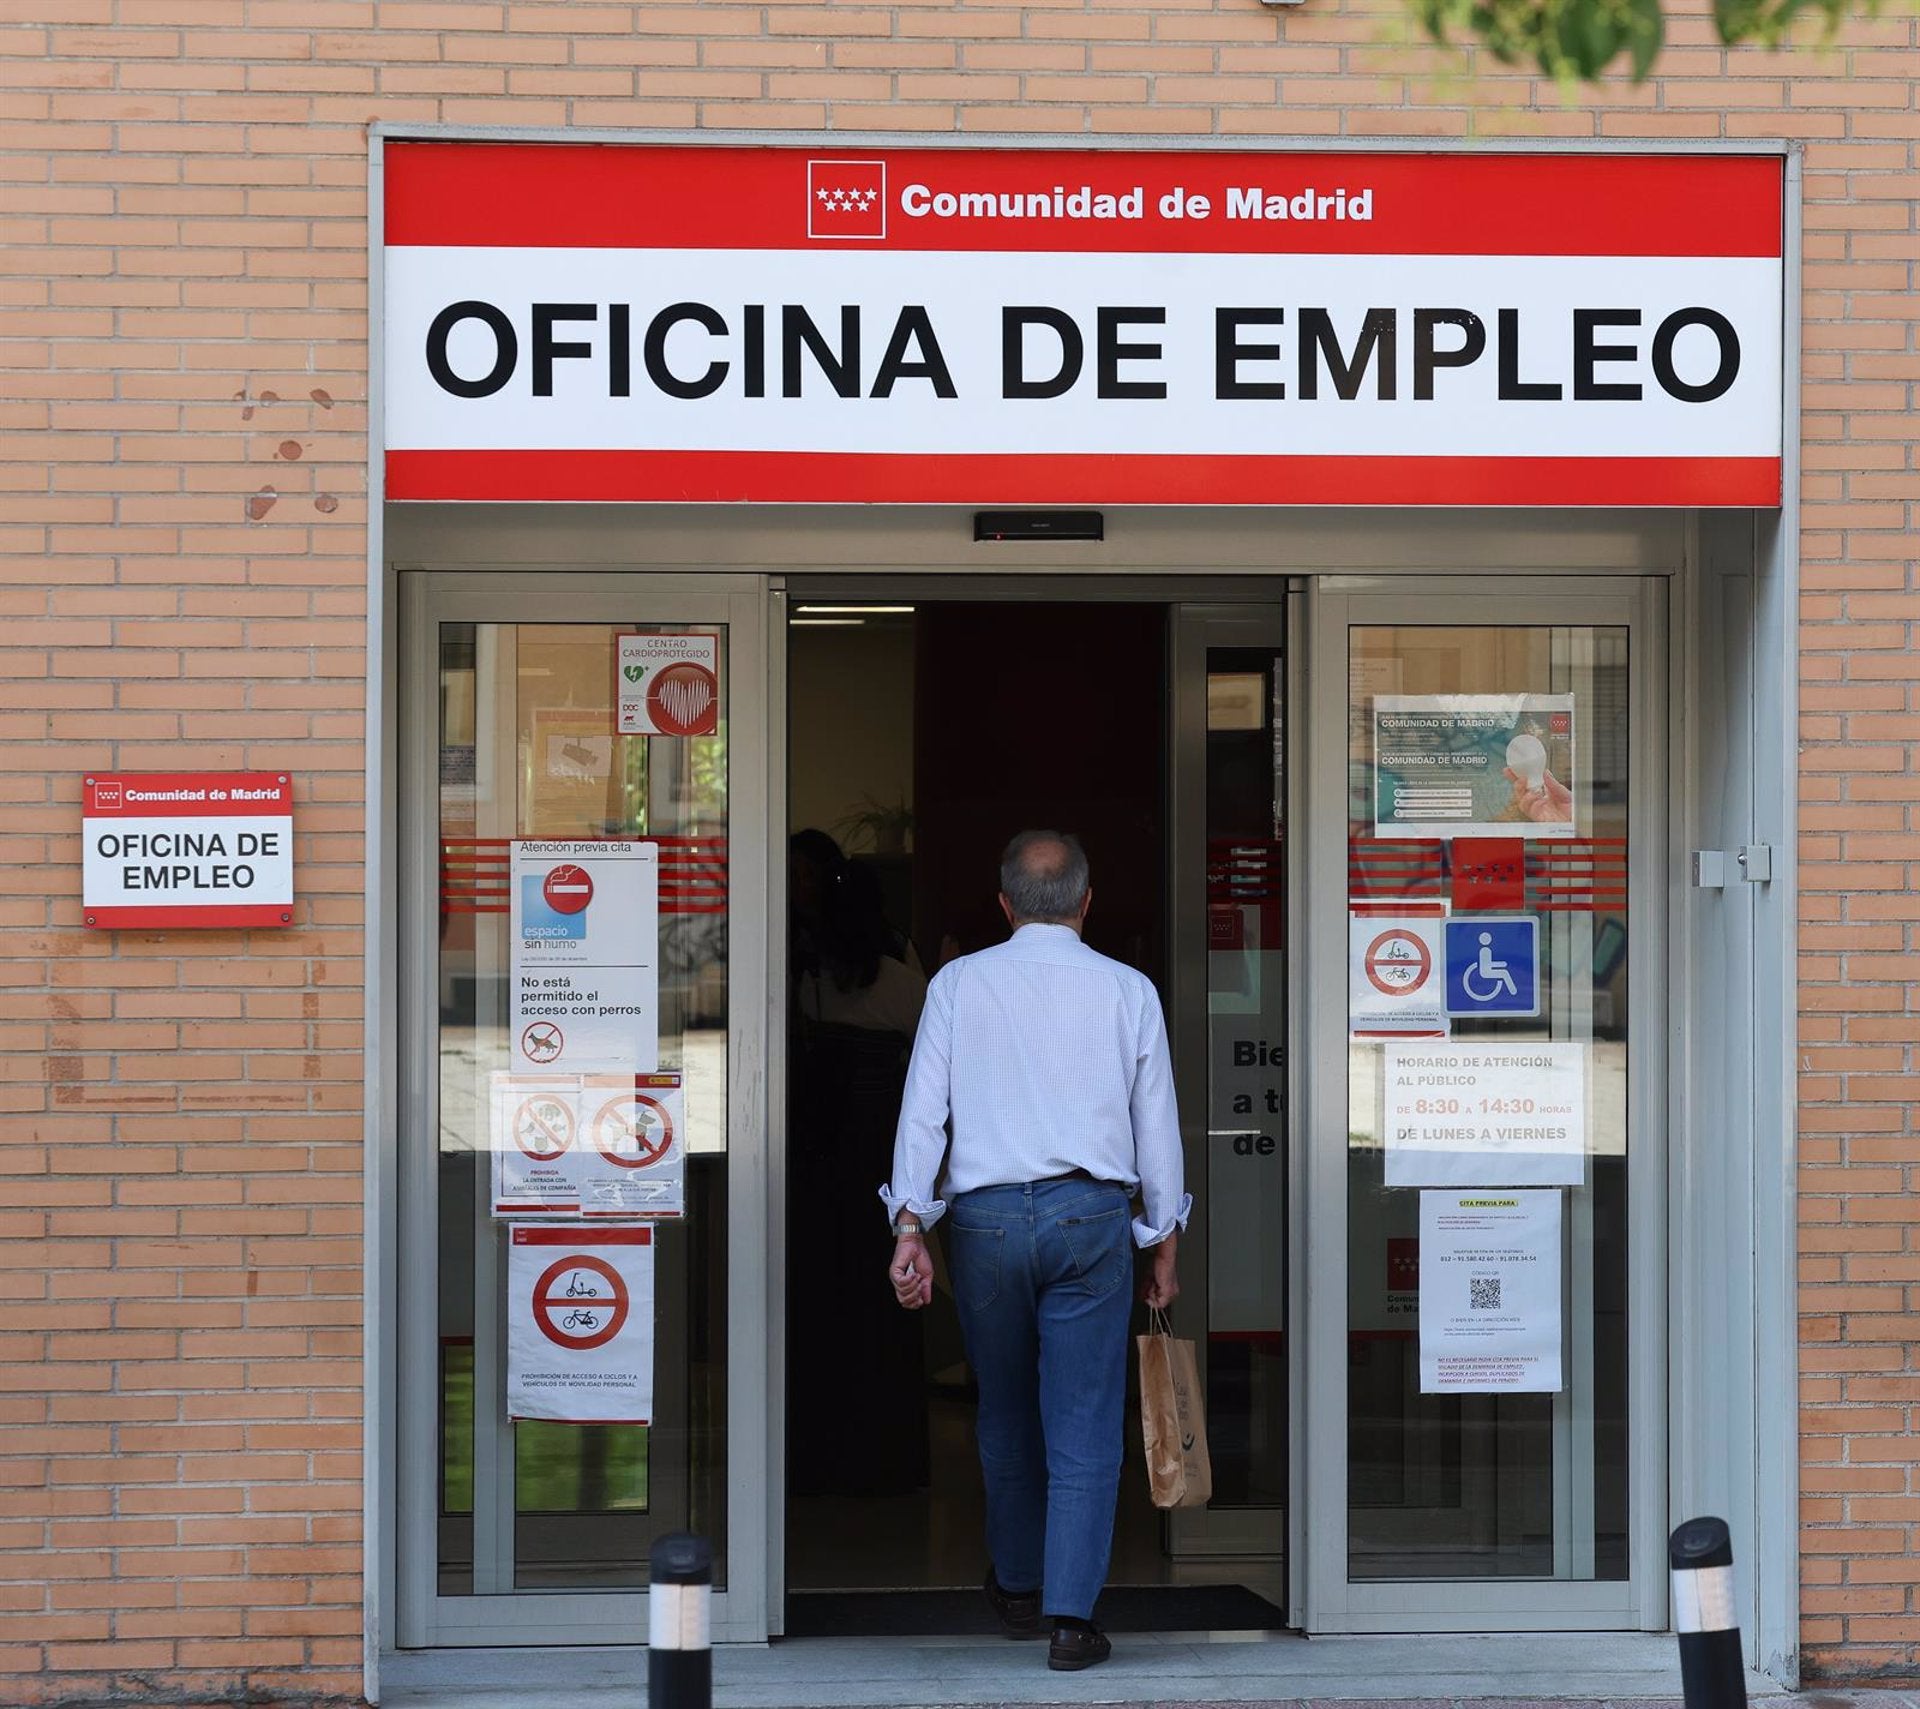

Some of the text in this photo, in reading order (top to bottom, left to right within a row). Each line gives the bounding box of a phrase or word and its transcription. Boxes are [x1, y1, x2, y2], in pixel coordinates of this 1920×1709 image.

[902, 185, 1372, 220] Comunidad de Madrid
[426, 301, 1740, 402] OFICINA DE EMPLEO
[647, 640, 687, 648] CENTRO
[623, 649, 710, 658] CARDIOPROTEGIDO
[1381, 719, 1494, 728] COMUNIDAD DE MADRID
[1381, 756, 1488, 764] COMUNIDAD DE MADRID
[125, 788, 281, 802] Comunidad de Madrid
[97, 833, 279, 858] OFICINA DE
[520, 841, 631, 854] Atención previa cita
[123, 864, 255, 890] EMPLEO
[524, 926, 569, 939] espacio
[524, 938, 577, 949] sin humo
[521, 977, 571, 988] No está
[521, 991, 599, 1003] permitido el
[521, 1006, 642, 1017] acceso con perros
[1397, 1055, 1553, 1068] HORARIO DE ATENCIÓN
[1397, 1074, 1476, 1086] AL PÚBLICO
[1232, 1094, 1252, 1114] a
[1397, 1106, 1411, 1114] DE
[1415, 1099, 1459, 1114] 8:30
[1479, 1098, 1534, 1114] 14:30
[1539, 1106, 1572, 1114] HORAS
[1397, 1127, 1567, 1140] DE LUNES A VIERNES
[1233, 1133, 1275, 1156] de
